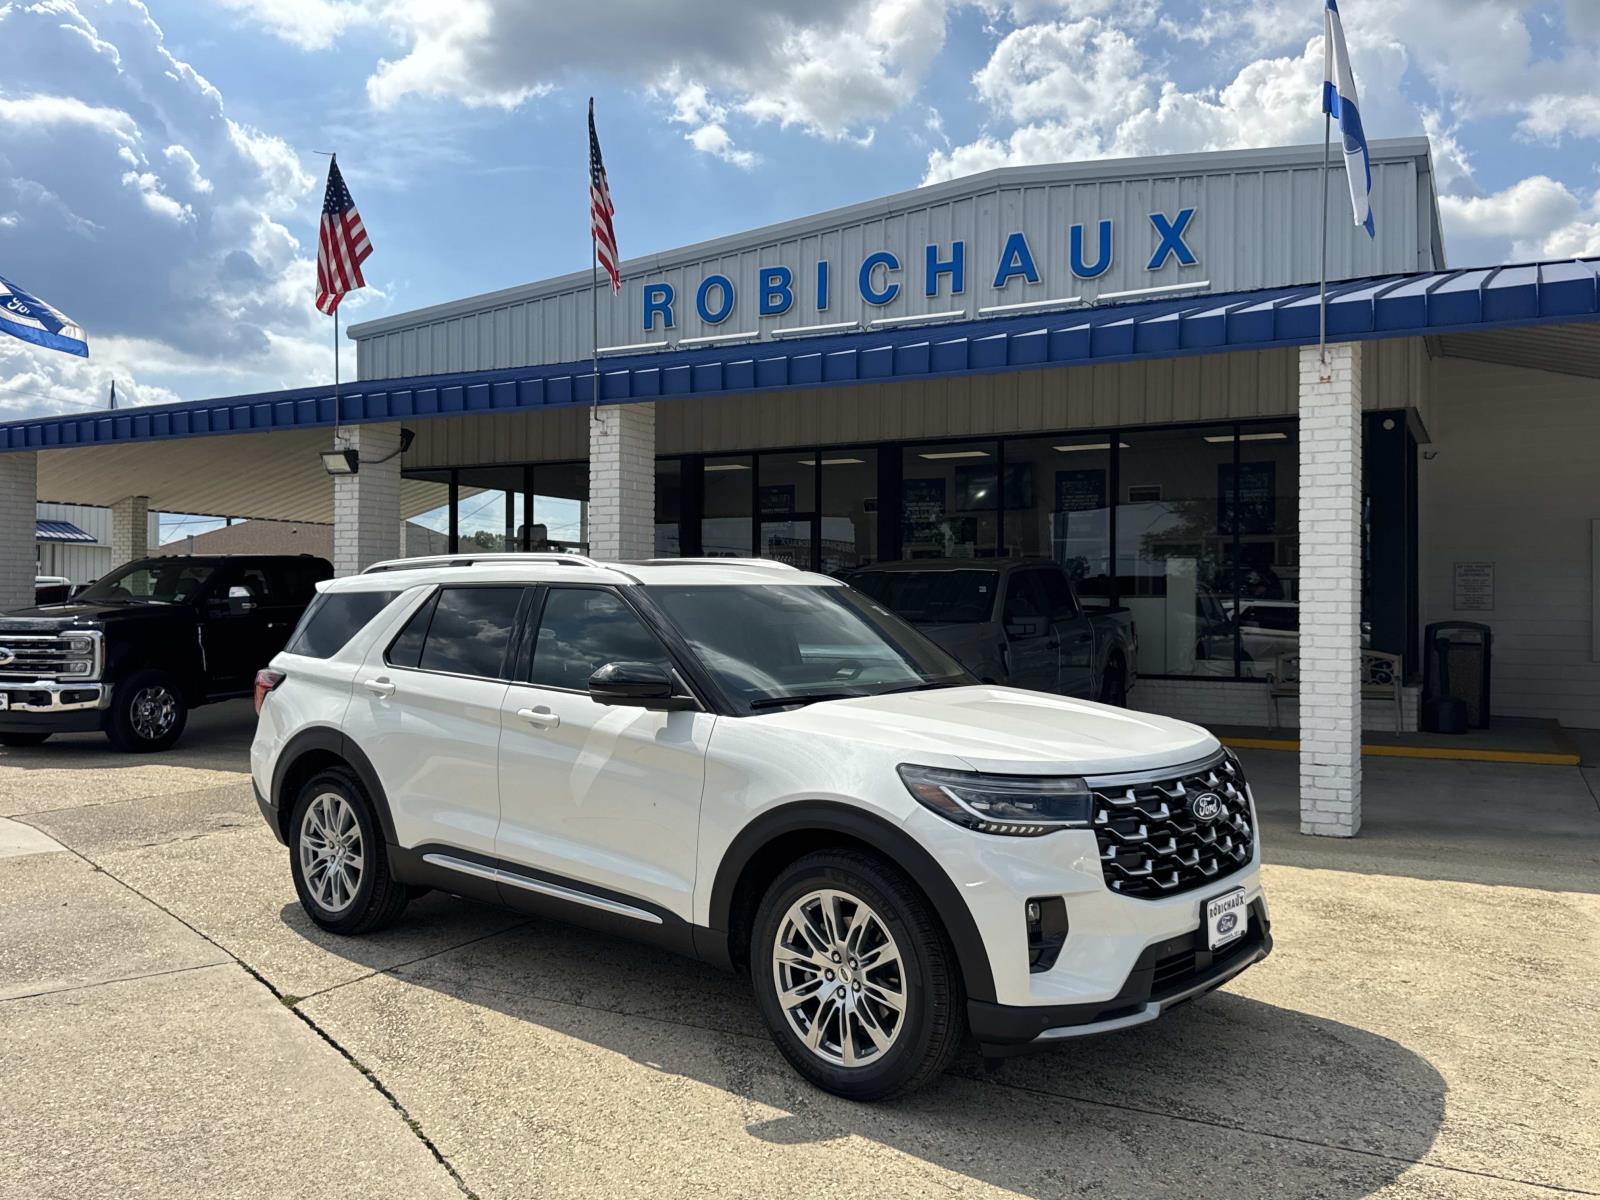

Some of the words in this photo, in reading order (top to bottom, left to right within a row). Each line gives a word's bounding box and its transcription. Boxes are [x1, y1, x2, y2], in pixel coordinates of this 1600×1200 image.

[642, 206, 1199, 332] ROBICHAUX
[1199, 796, 1217, 816] Ford
[1209, 895, 1244, 918] ROBICHAUX
